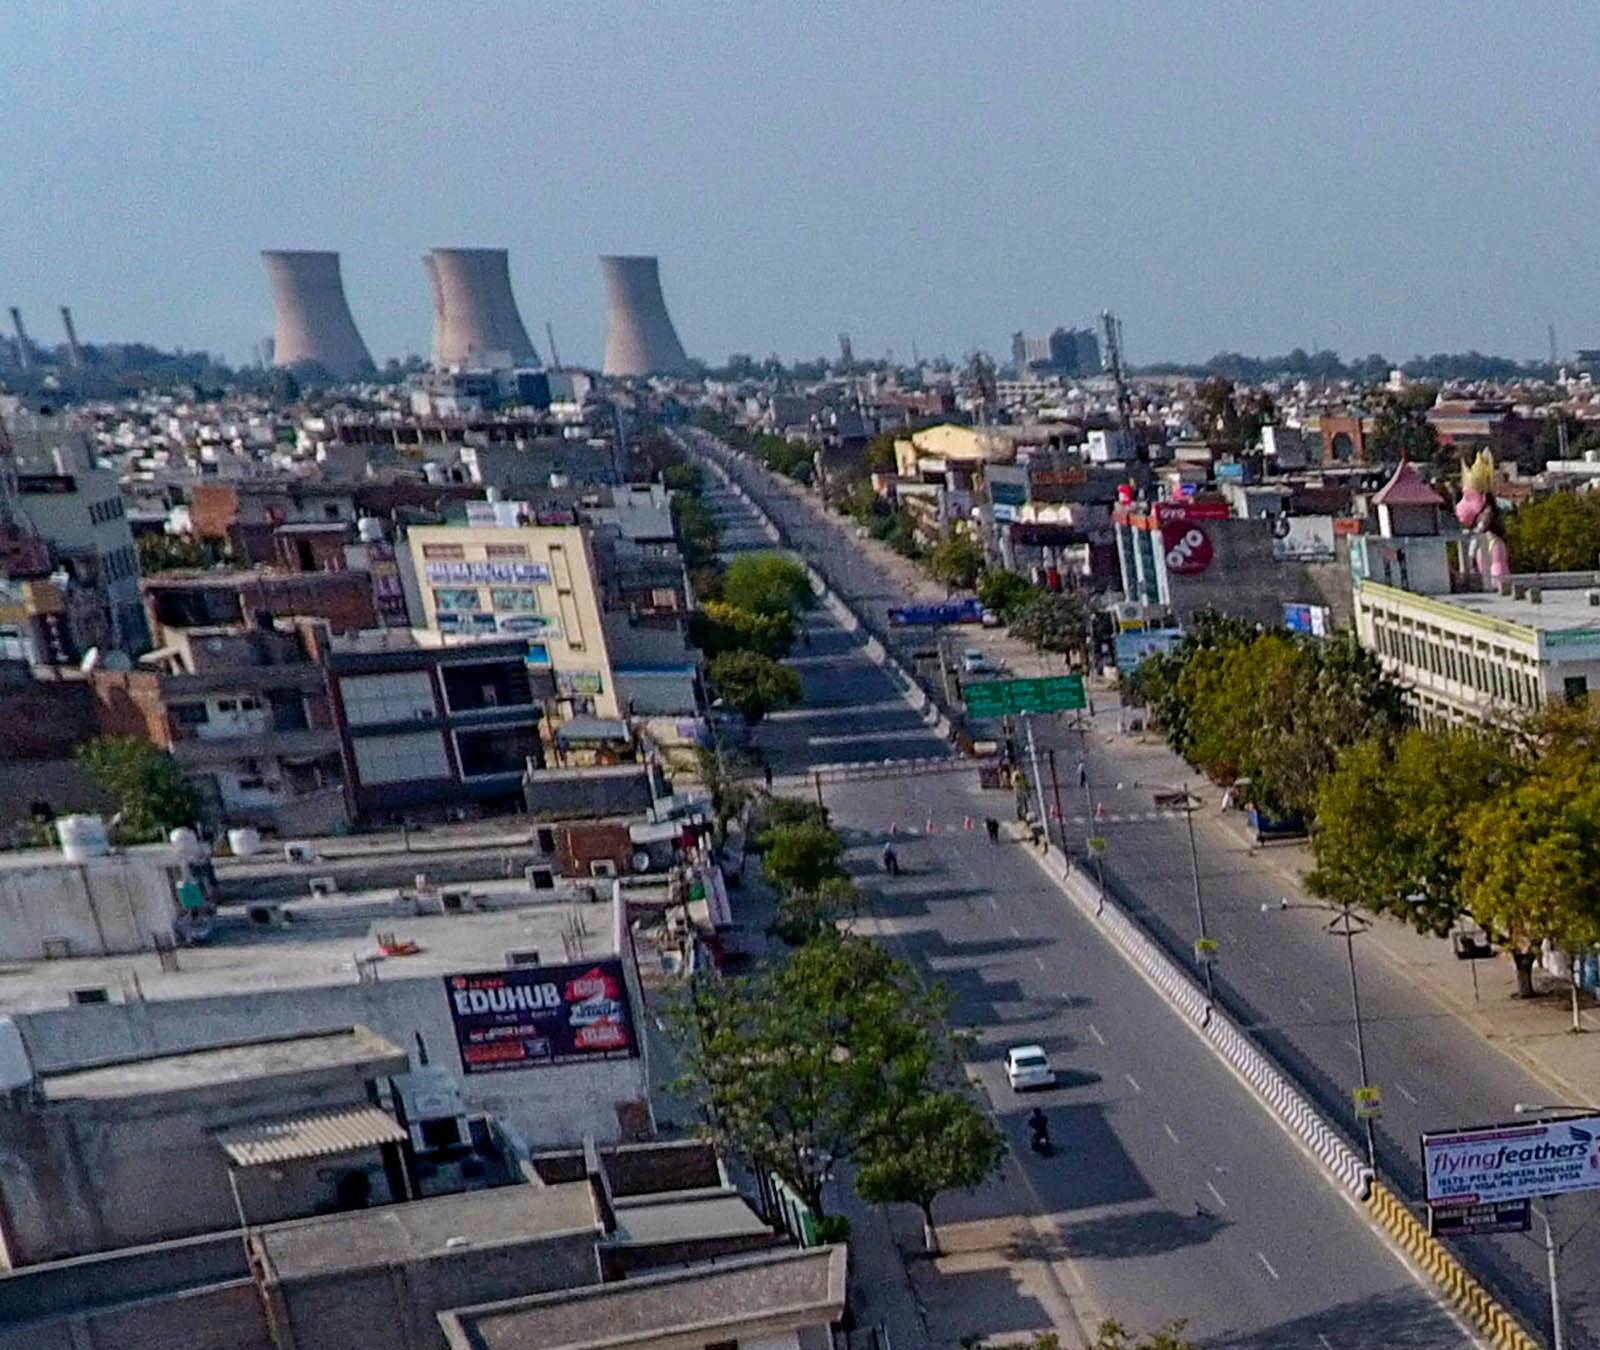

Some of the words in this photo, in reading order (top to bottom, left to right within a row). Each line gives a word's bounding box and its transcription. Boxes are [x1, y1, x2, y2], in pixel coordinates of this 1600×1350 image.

[1166, 529, 1204, 568] OYO
[455, 982, 562, 1016] EDUHUB
[1433, 1141, 1589, 1175] flyingfeathers
